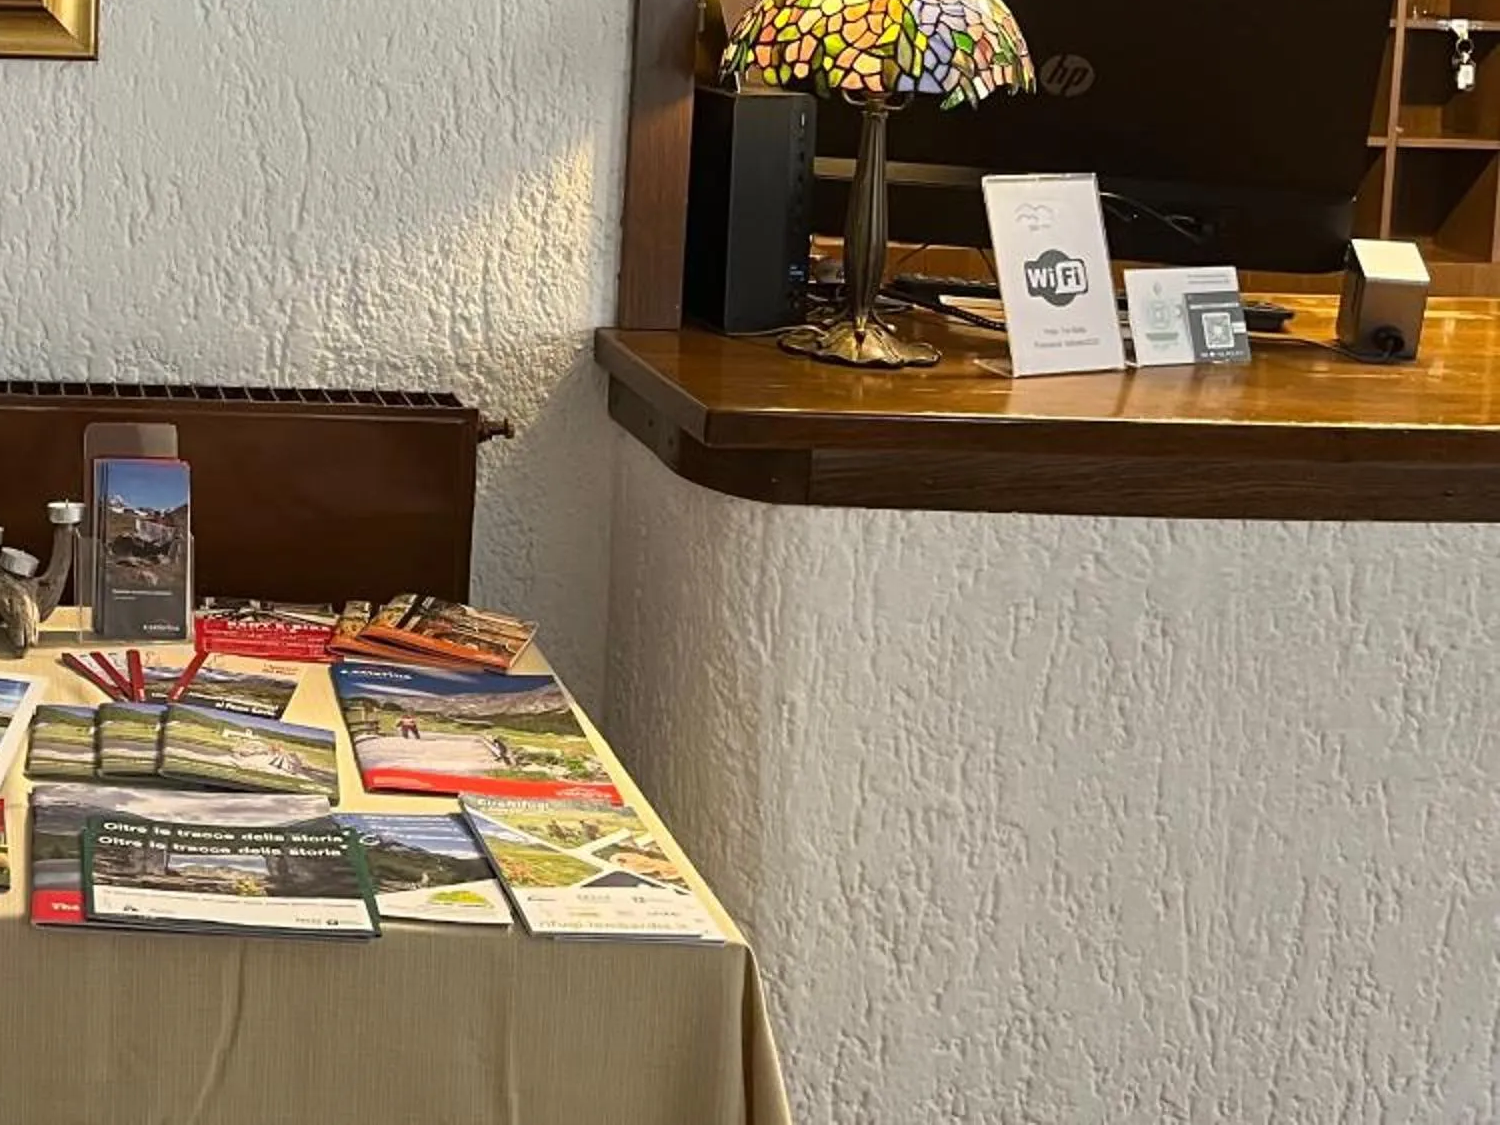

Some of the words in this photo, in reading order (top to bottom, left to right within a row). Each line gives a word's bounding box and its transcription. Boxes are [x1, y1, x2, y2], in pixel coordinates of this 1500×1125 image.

[1046, 53, 1090, 96] hp
[103, 822, 148, 834] Oltre
[241, 832, 285, 842] della
[98, 835, 143, 848] Oltre
[237, 845, 281, 856] della
